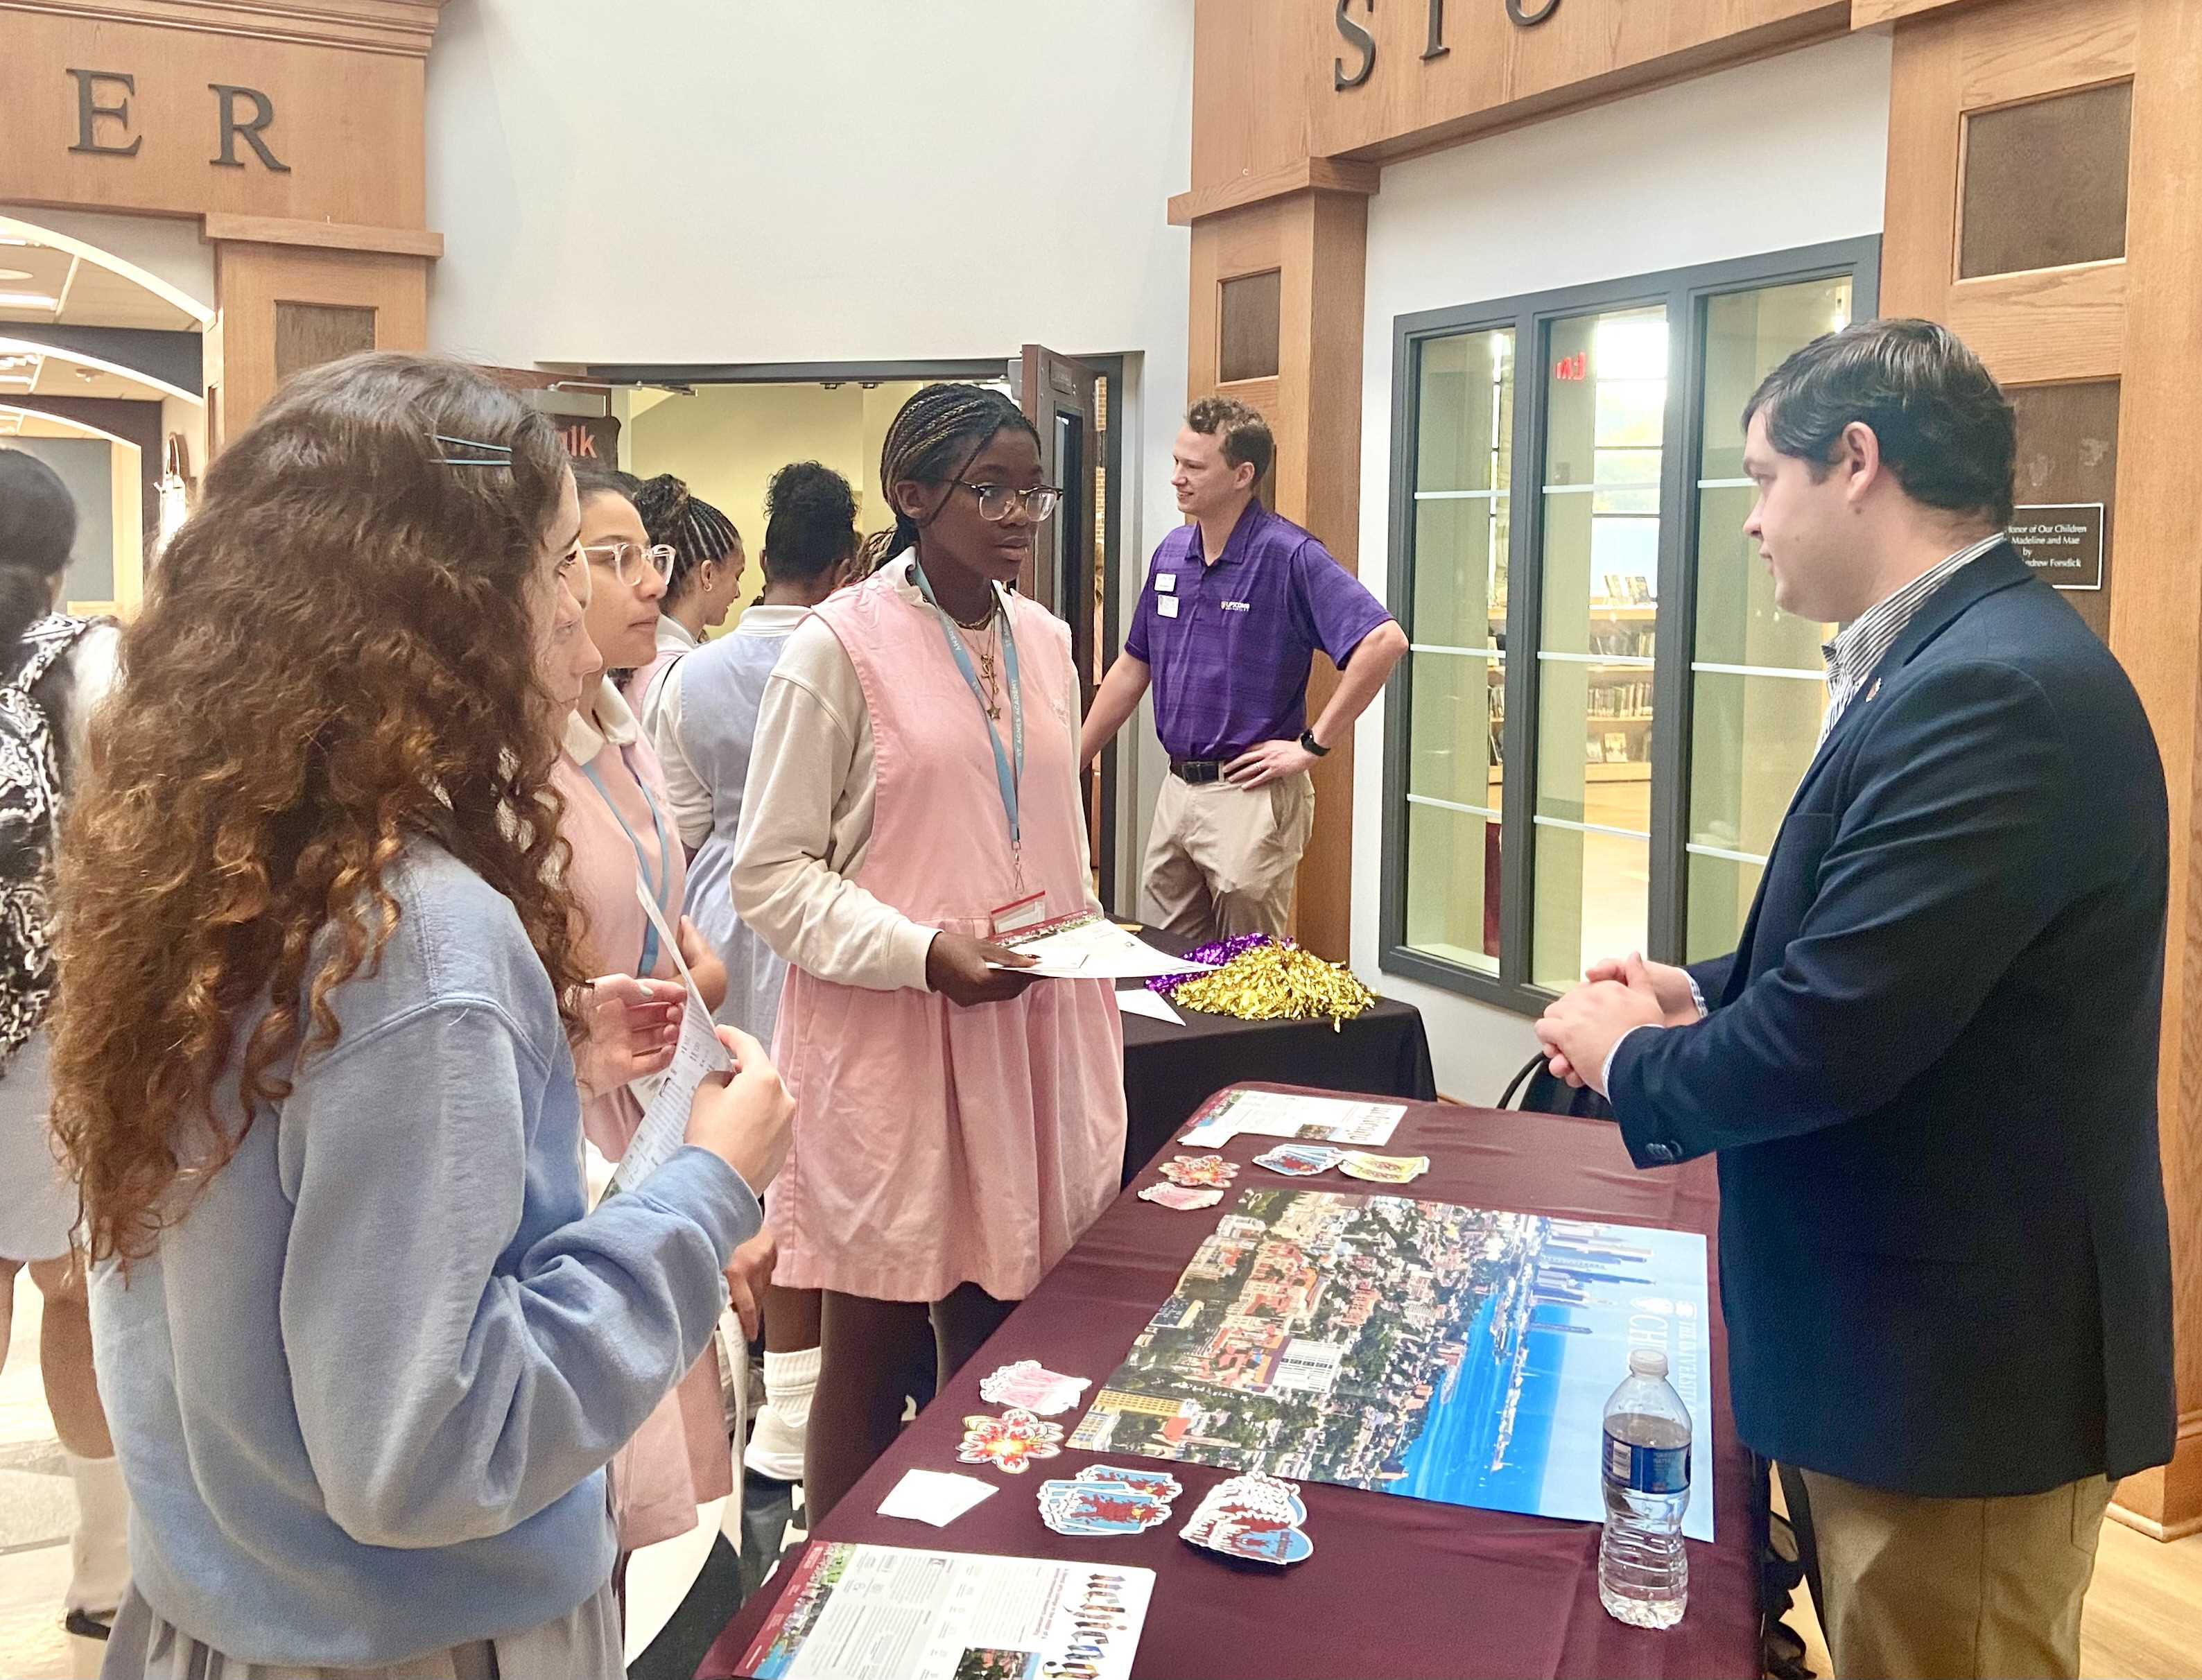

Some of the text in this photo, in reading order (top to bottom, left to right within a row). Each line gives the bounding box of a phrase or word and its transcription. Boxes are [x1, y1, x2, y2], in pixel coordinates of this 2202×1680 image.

[2029, 523, 2037, 533] of
[2038, 524, 2053, 533] Our
[2054, 523, 2087, 533] Children
[2011, 535, 2080, 545] Madeline and Mae
[2022, 546, 2032, 558] by
[2022, 557, 2048, 567] ndrew
[1011, 678, 1021, 716] ACADEMY
[1629, 1314, 1669, 1351] CHI
